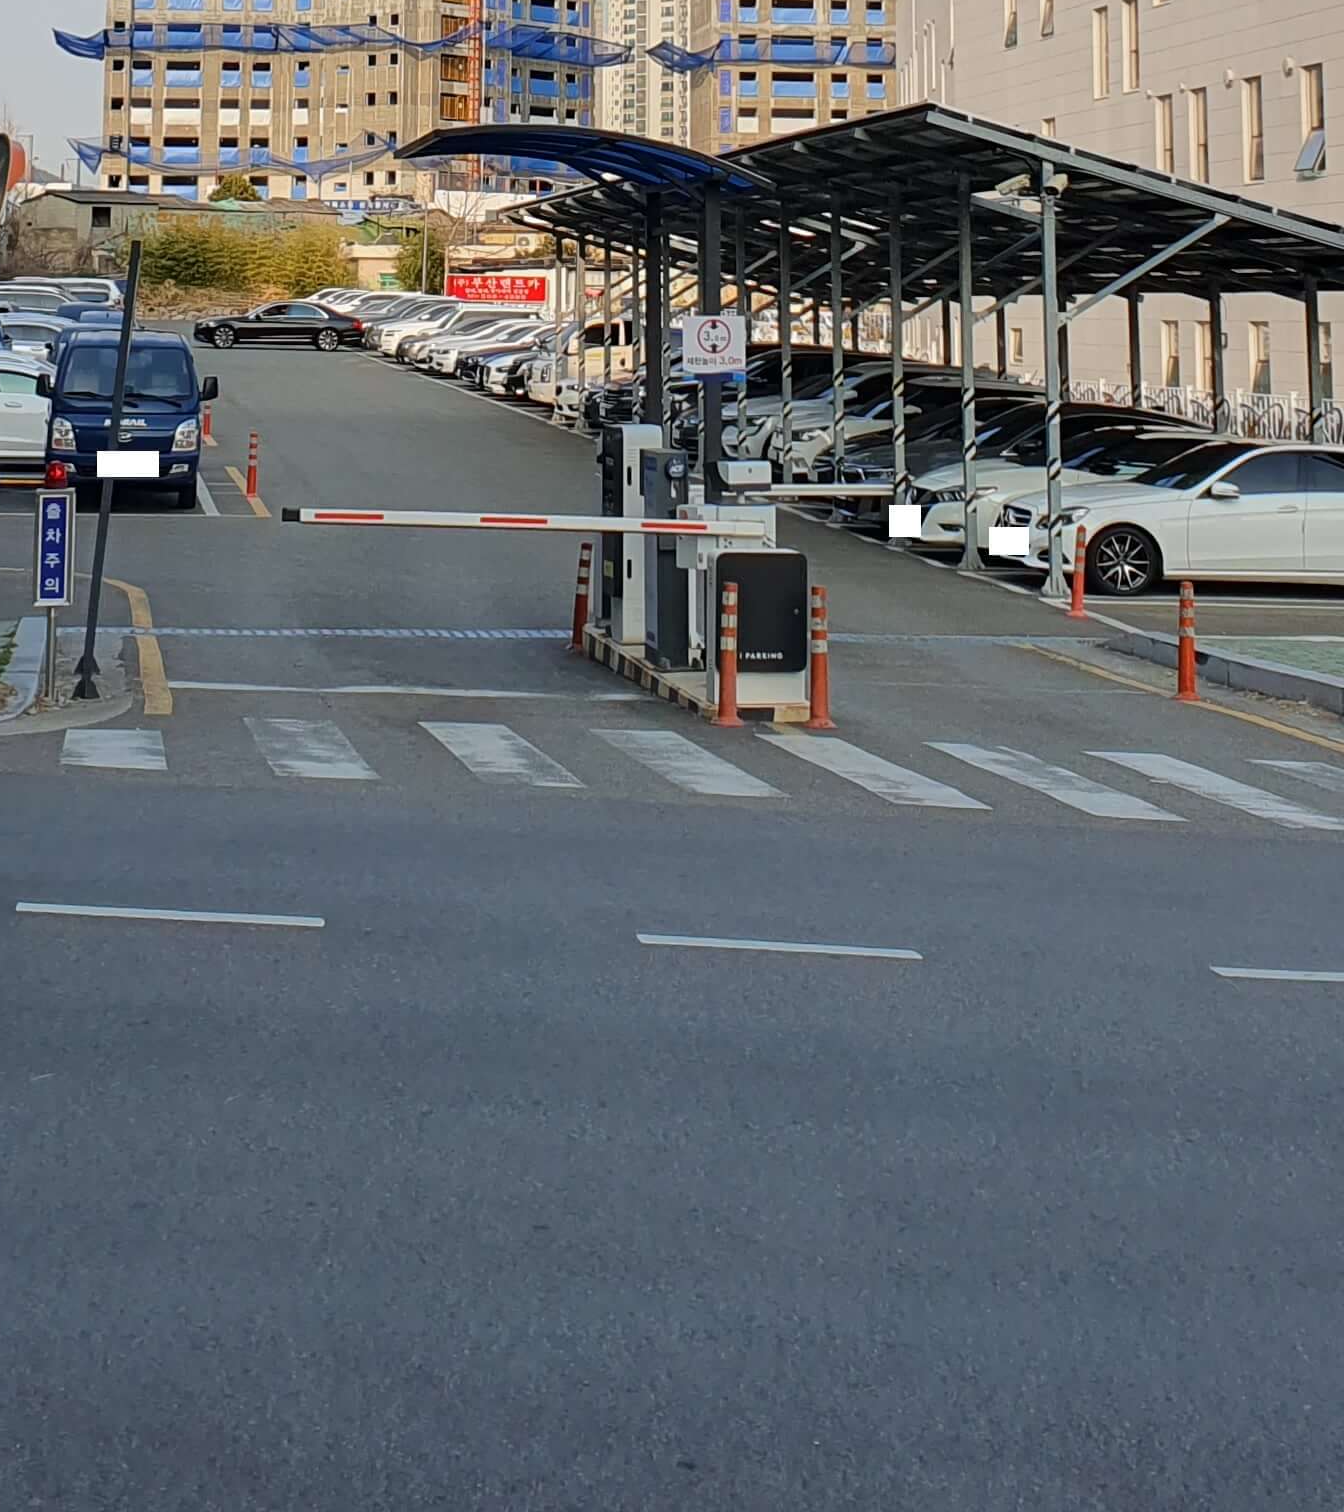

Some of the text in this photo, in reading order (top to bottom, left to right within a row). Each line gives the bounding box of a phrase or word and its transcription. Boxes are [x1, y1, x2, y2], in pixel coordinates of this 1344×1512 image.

[719, 356, 743, 366] 3.0m
[44, 503, 62, 593] 출차주의
[745, 651, 784, 660] PARKING
